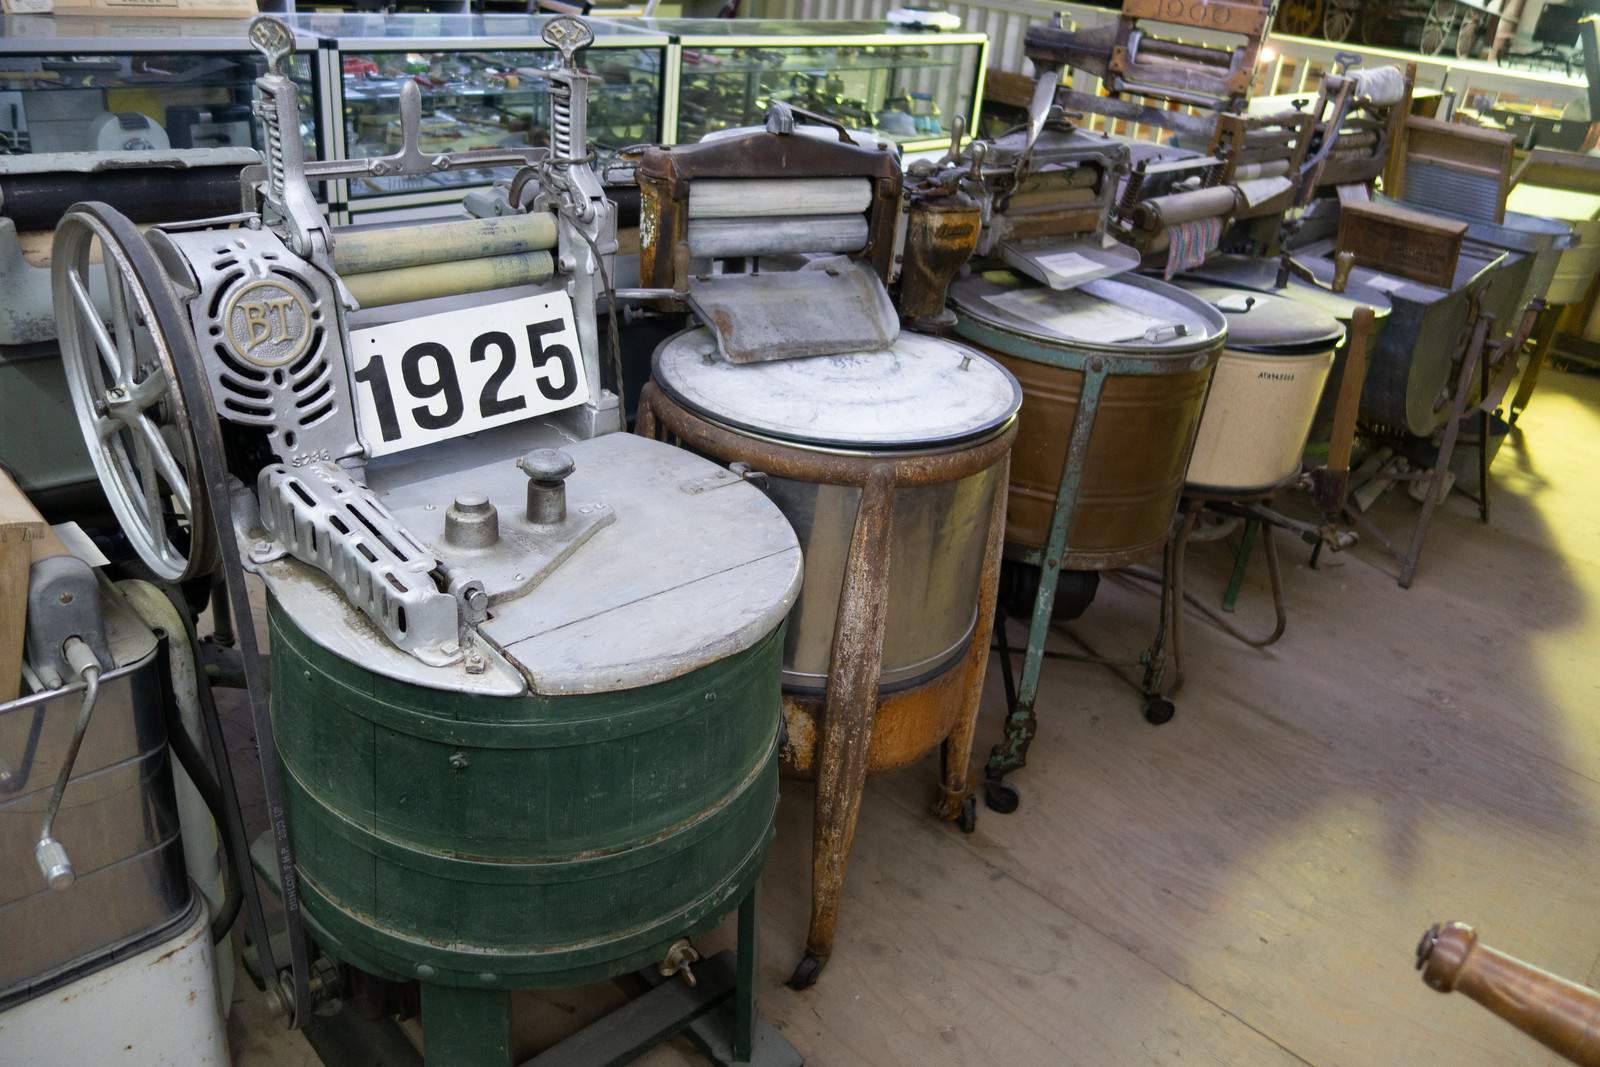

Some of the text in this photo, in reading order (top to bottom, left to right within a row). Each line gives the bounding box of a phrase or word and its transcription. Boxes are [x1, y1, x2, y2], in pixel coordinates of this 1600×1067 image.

[253, 23, 286, 48] BT
[546, 21, 587, 42] BT
[235, 296, 295, 351] BT
[355, 317, 578, 442] 1925
